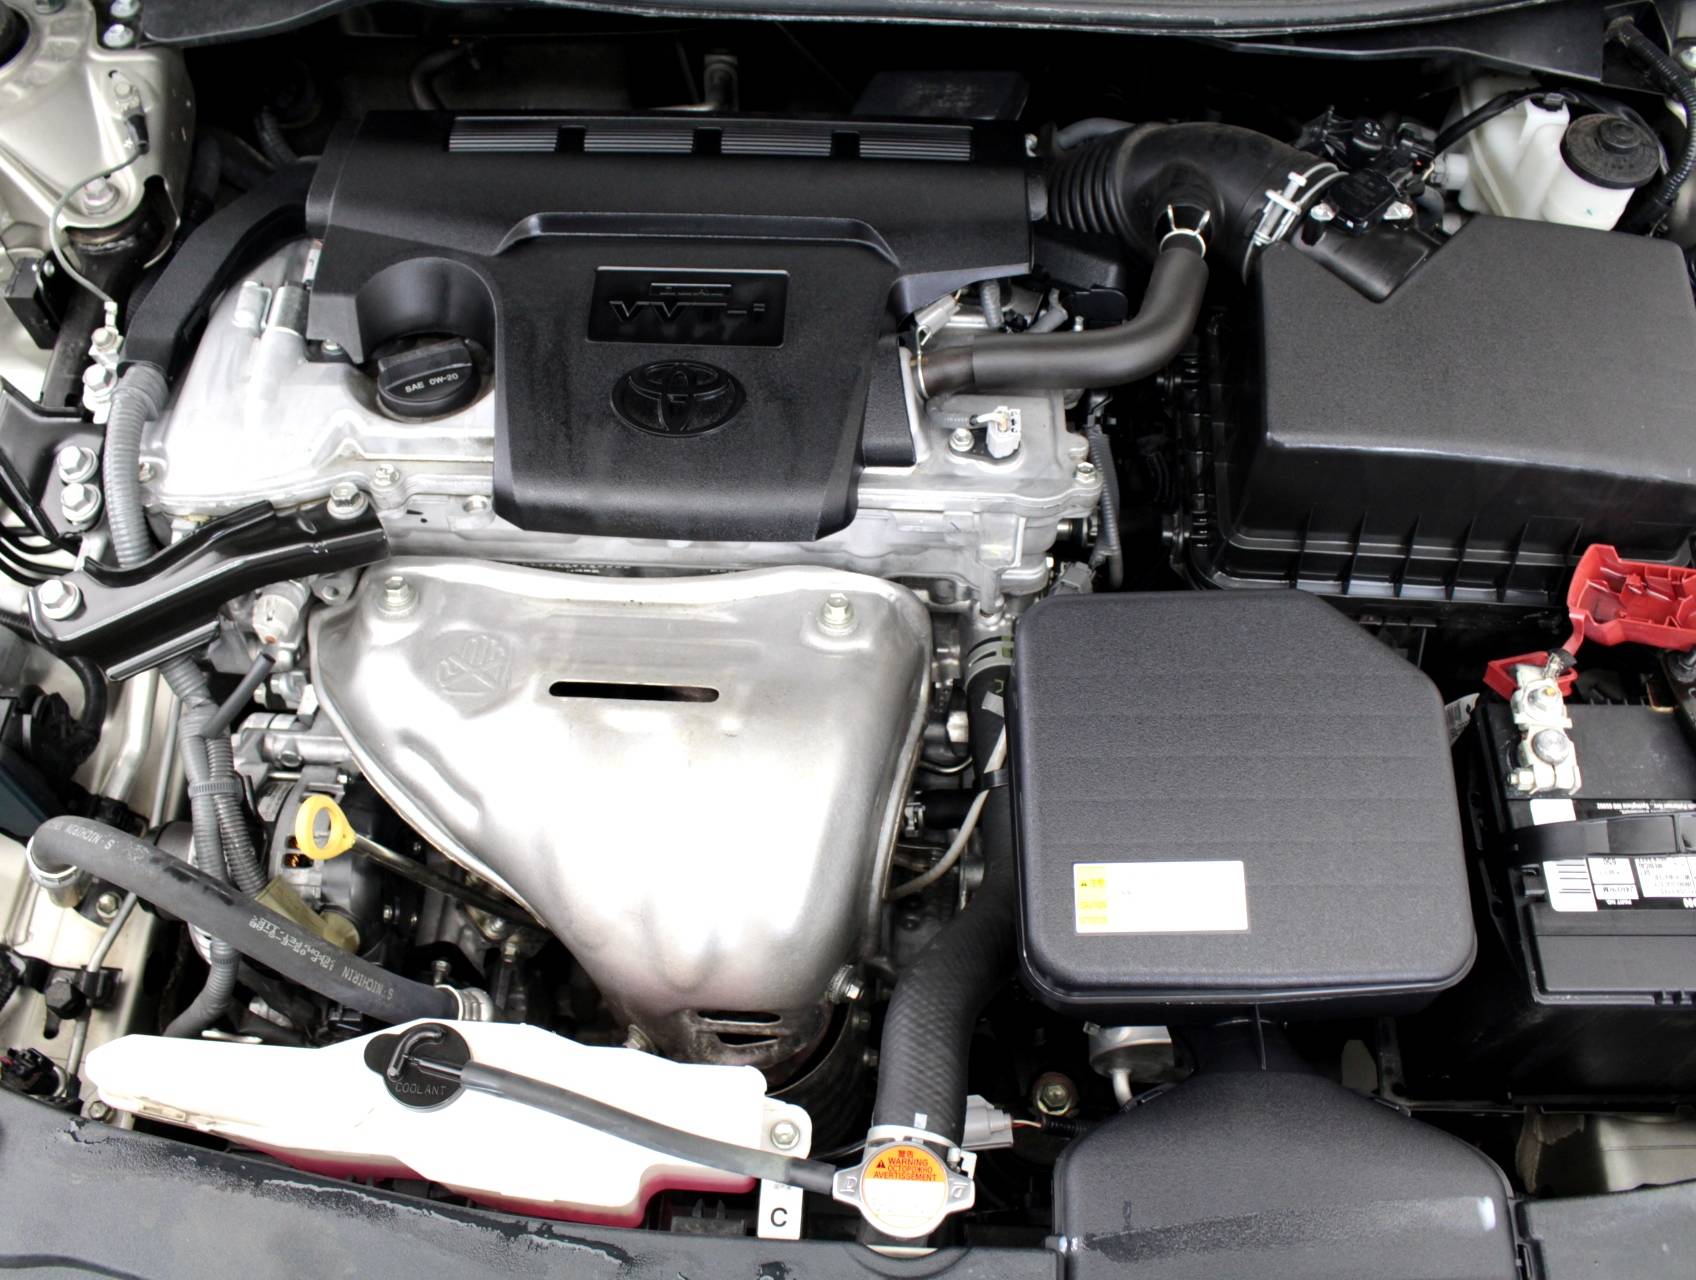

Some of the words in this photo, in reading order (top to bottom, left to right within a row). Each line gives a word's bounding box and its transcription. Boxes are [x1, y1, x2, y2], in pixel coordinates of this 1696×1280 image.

[404, 381, 425, 393] SAE
[428, 372, 459, 386] 0W-20
[341, 965, 384, 995] NICHIRIN
[395, 1082, 447, 1096] COOLANT
[888, 1157, 928, 1167] WARNING
[873, 1170, 937, 1181] AVERTISSEMENT
[770, 1207, 788, 1228] C
